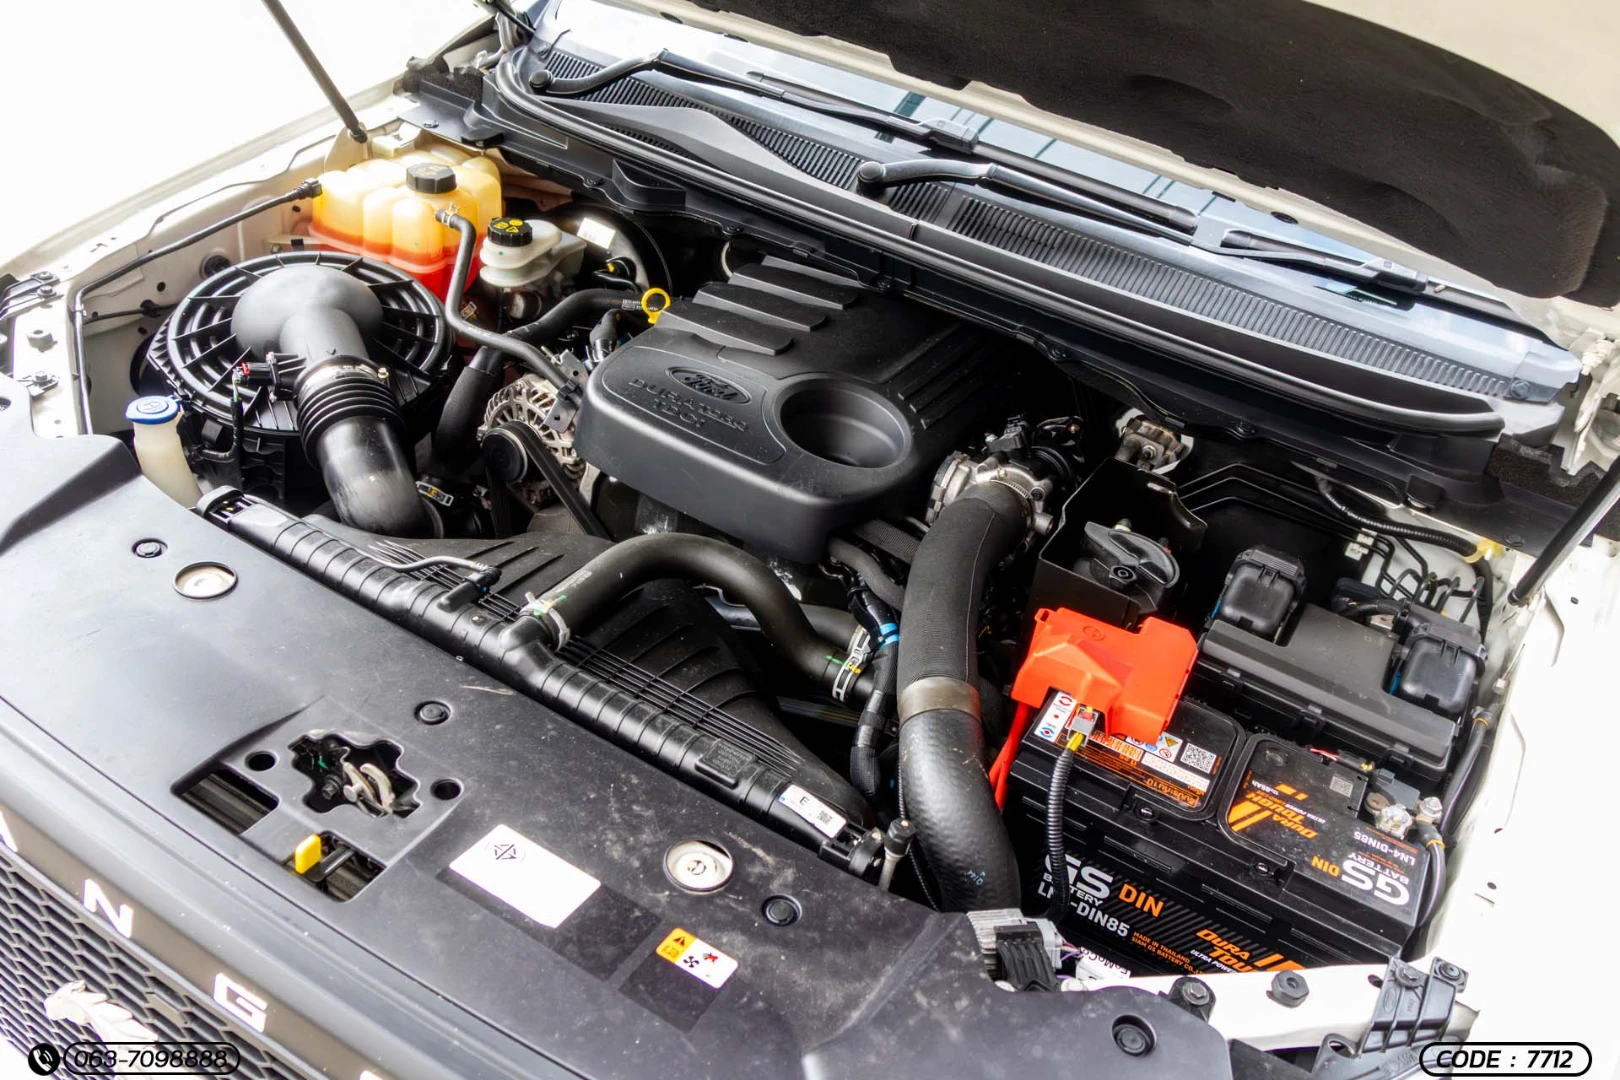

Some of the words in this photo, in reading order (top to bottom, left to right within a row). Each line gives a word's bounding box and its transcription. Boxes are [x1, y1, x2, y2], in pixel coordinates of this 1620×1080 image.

[1272, 813, 1319, 840] DURA
[1353, 830, 1416, 866] LN4-DIN85
[1310, 854, 1341, 878] DIN
[1341, 858, 1410, 906] GS
[1347, 851, 1410, 886] BATTERY
[1043, 872, 1104, 907] BTERY
[1118, 883, 1165, 918] DIN
[1131, 936, 1148, 949] SIAM
[1147, 945, 1157, 954] GS
[1156, 949, 1184, 968] BATTERY
[1133, 931, 1152, 944] MADE
[1152, 940, 1160, 949] IN
[1160, 943, 1191, 964] THAILAND
[1190, 949, 1212, 963] ULTRA
[1196, 928, 1251, 961] DURA
